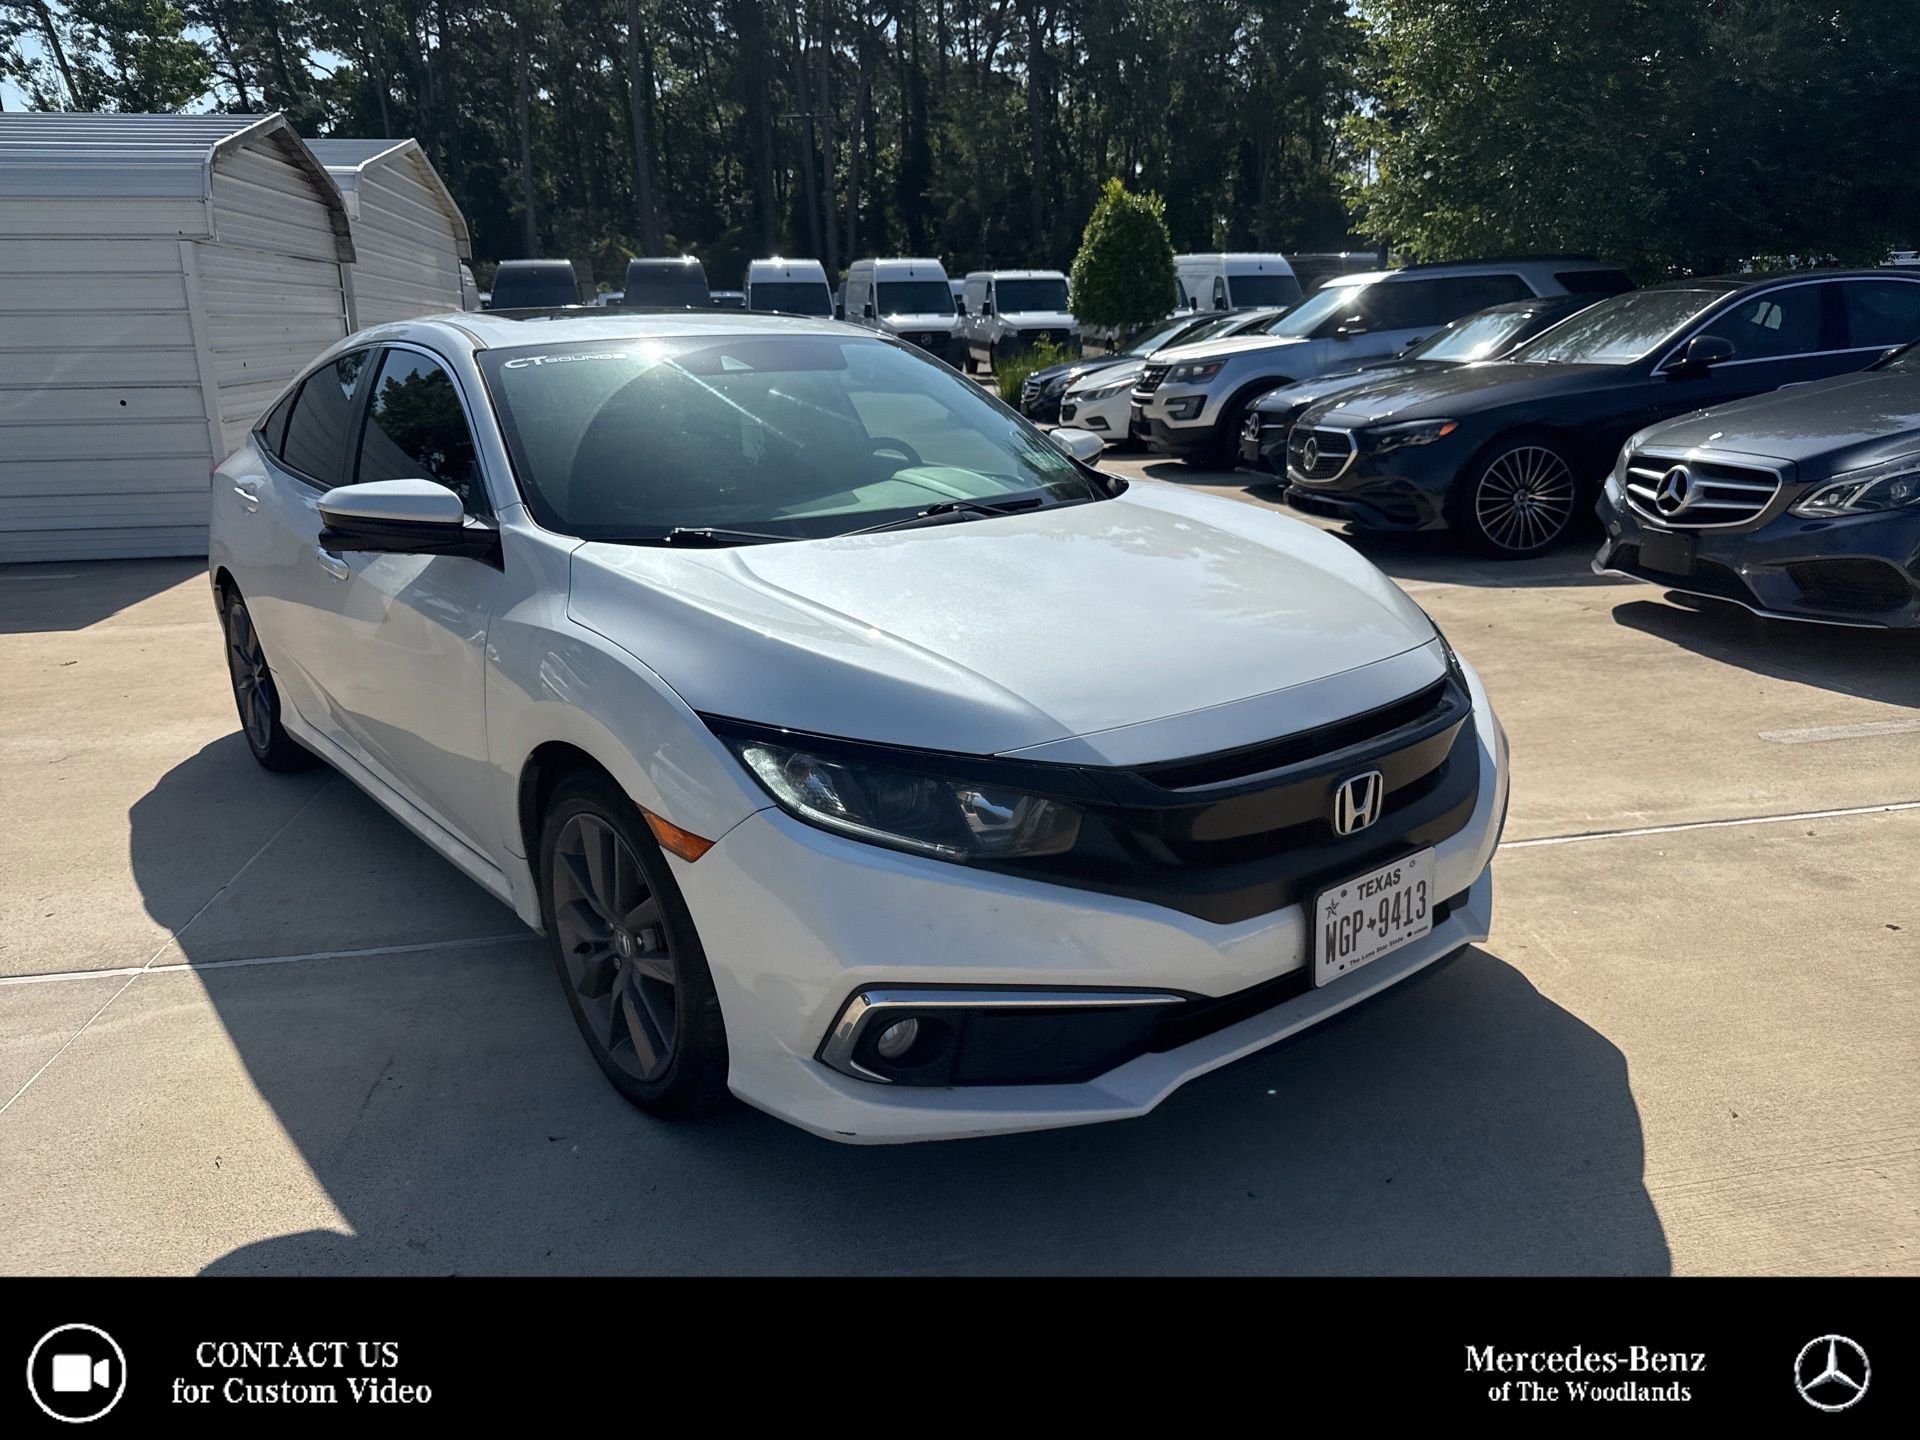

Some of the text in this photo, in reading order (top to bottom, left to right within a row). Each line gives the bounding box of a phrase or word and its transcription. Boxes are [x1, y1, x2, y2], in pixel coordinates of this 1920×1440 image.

[1357, 868, 1401, 900] TEXAS
[1326, 880, 1427, 965] WGP 9413
